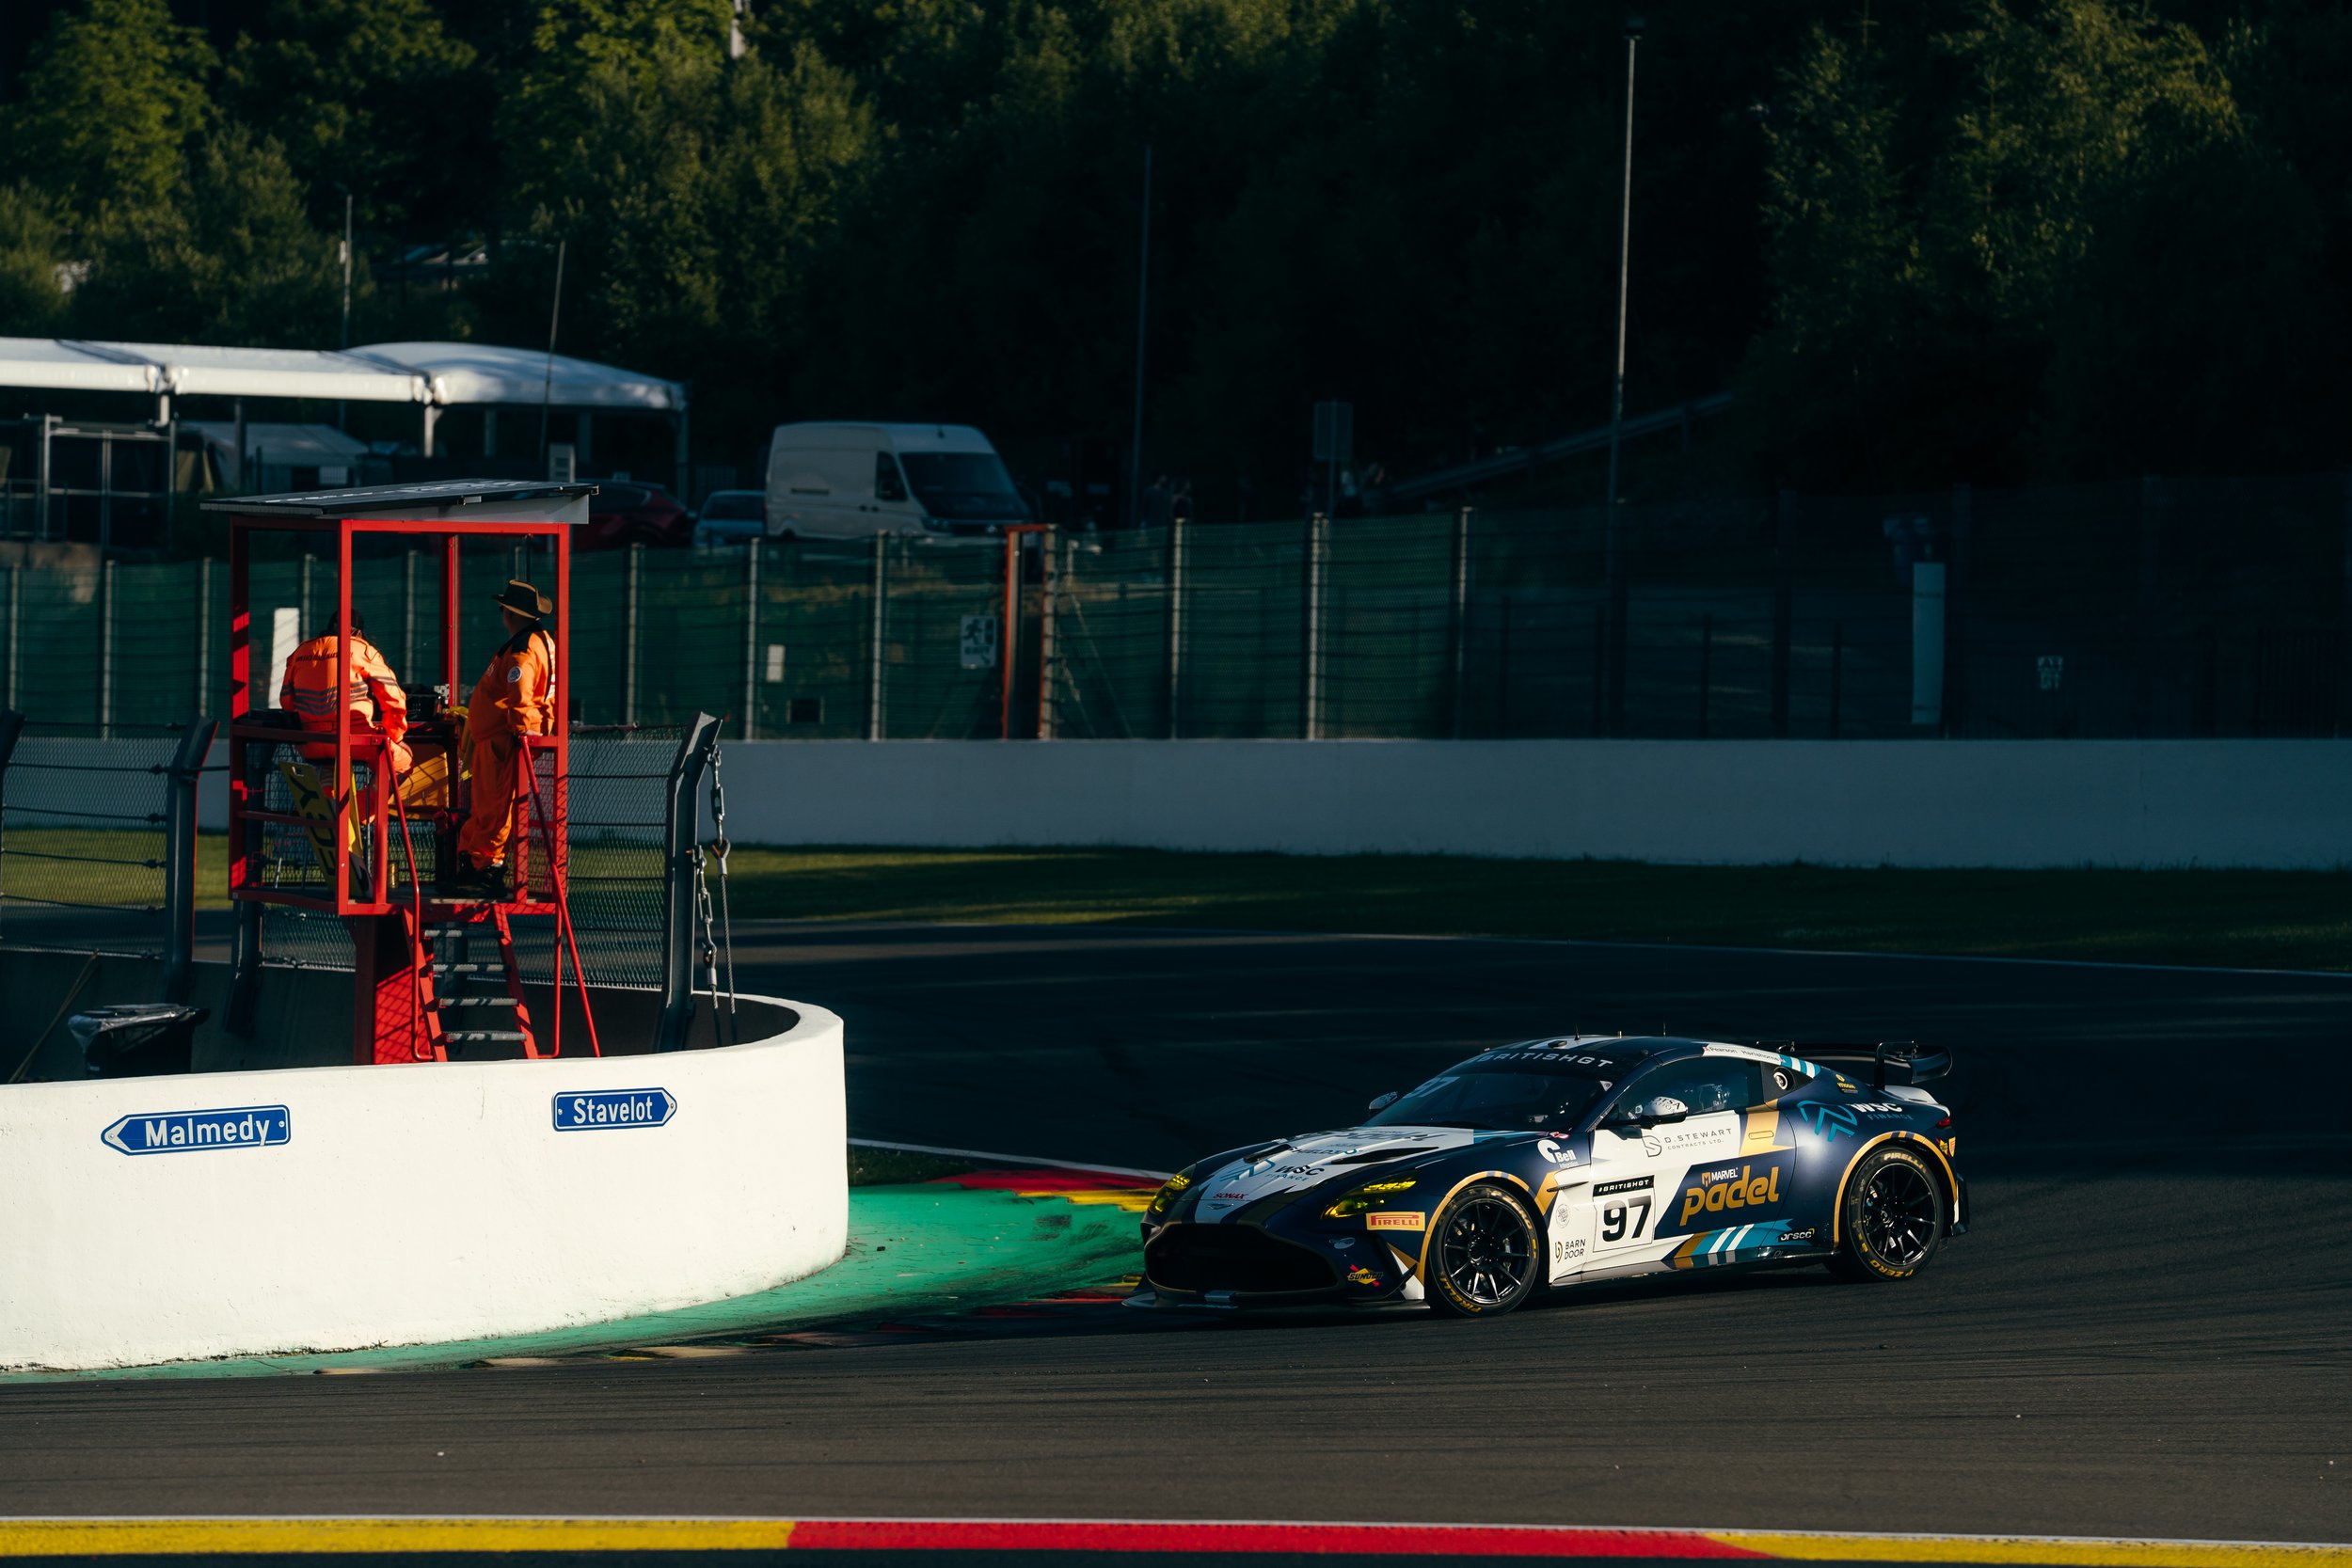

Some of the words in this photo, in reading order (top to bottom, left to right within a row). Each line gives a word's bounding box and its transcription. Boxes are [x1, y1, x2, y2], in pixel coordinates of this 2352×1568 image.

[1476, 1053, 1613, 1068] BRITISHGT
[573, 1095, 653, 1124] Stavelot
[1845, 1102, 1903, 1113] WSC
[145, 1114, 270, 1147] Malmedy
[1668, 1141, 1707, 1150] CONTRACTS
[1554, 1148, 1577, 1163] Bell
[1883, 1152, 1927, 1173] PIRELLI
[1264, 1173, 1310, 1181] FINANCE
[1275, 1164, 1325, 1176] WSC
[1678, 1164, 1780, 1227] padel
[1371, 1214, 1420, 1226] PIRELLI
[1602, 1195, 1652, 1242] 97
[1565, 1239, 1586, 1250] BARN
[1564, 1248, 1584, 1259] DOOR
[1868, 1259, 1904, 1278] ZERO
[1438, 1275, 1483, 1314] PIRELLI
